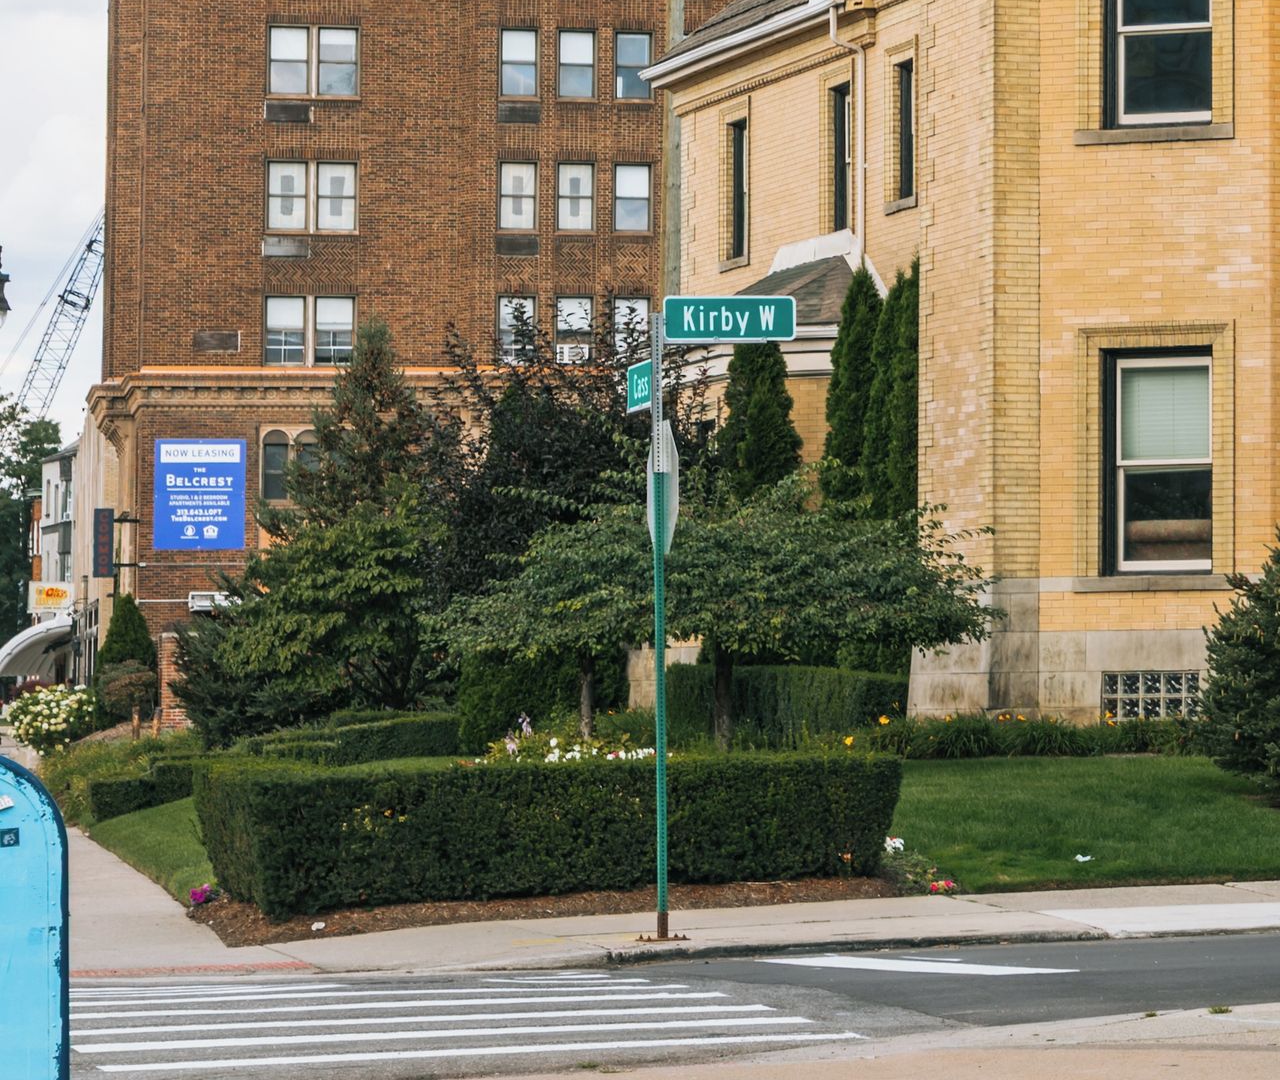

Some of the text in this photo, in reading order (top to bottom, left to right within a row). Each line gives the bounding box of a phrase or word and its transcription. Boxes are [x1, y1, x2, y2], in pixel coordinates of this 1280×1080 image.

[683, 305, 775, 336] Kirby W
[633, 374, 648, 400] Cass
[165, 449, 235, 457] NOW LEASING
[166, 473, 233, 486] BELCREST
